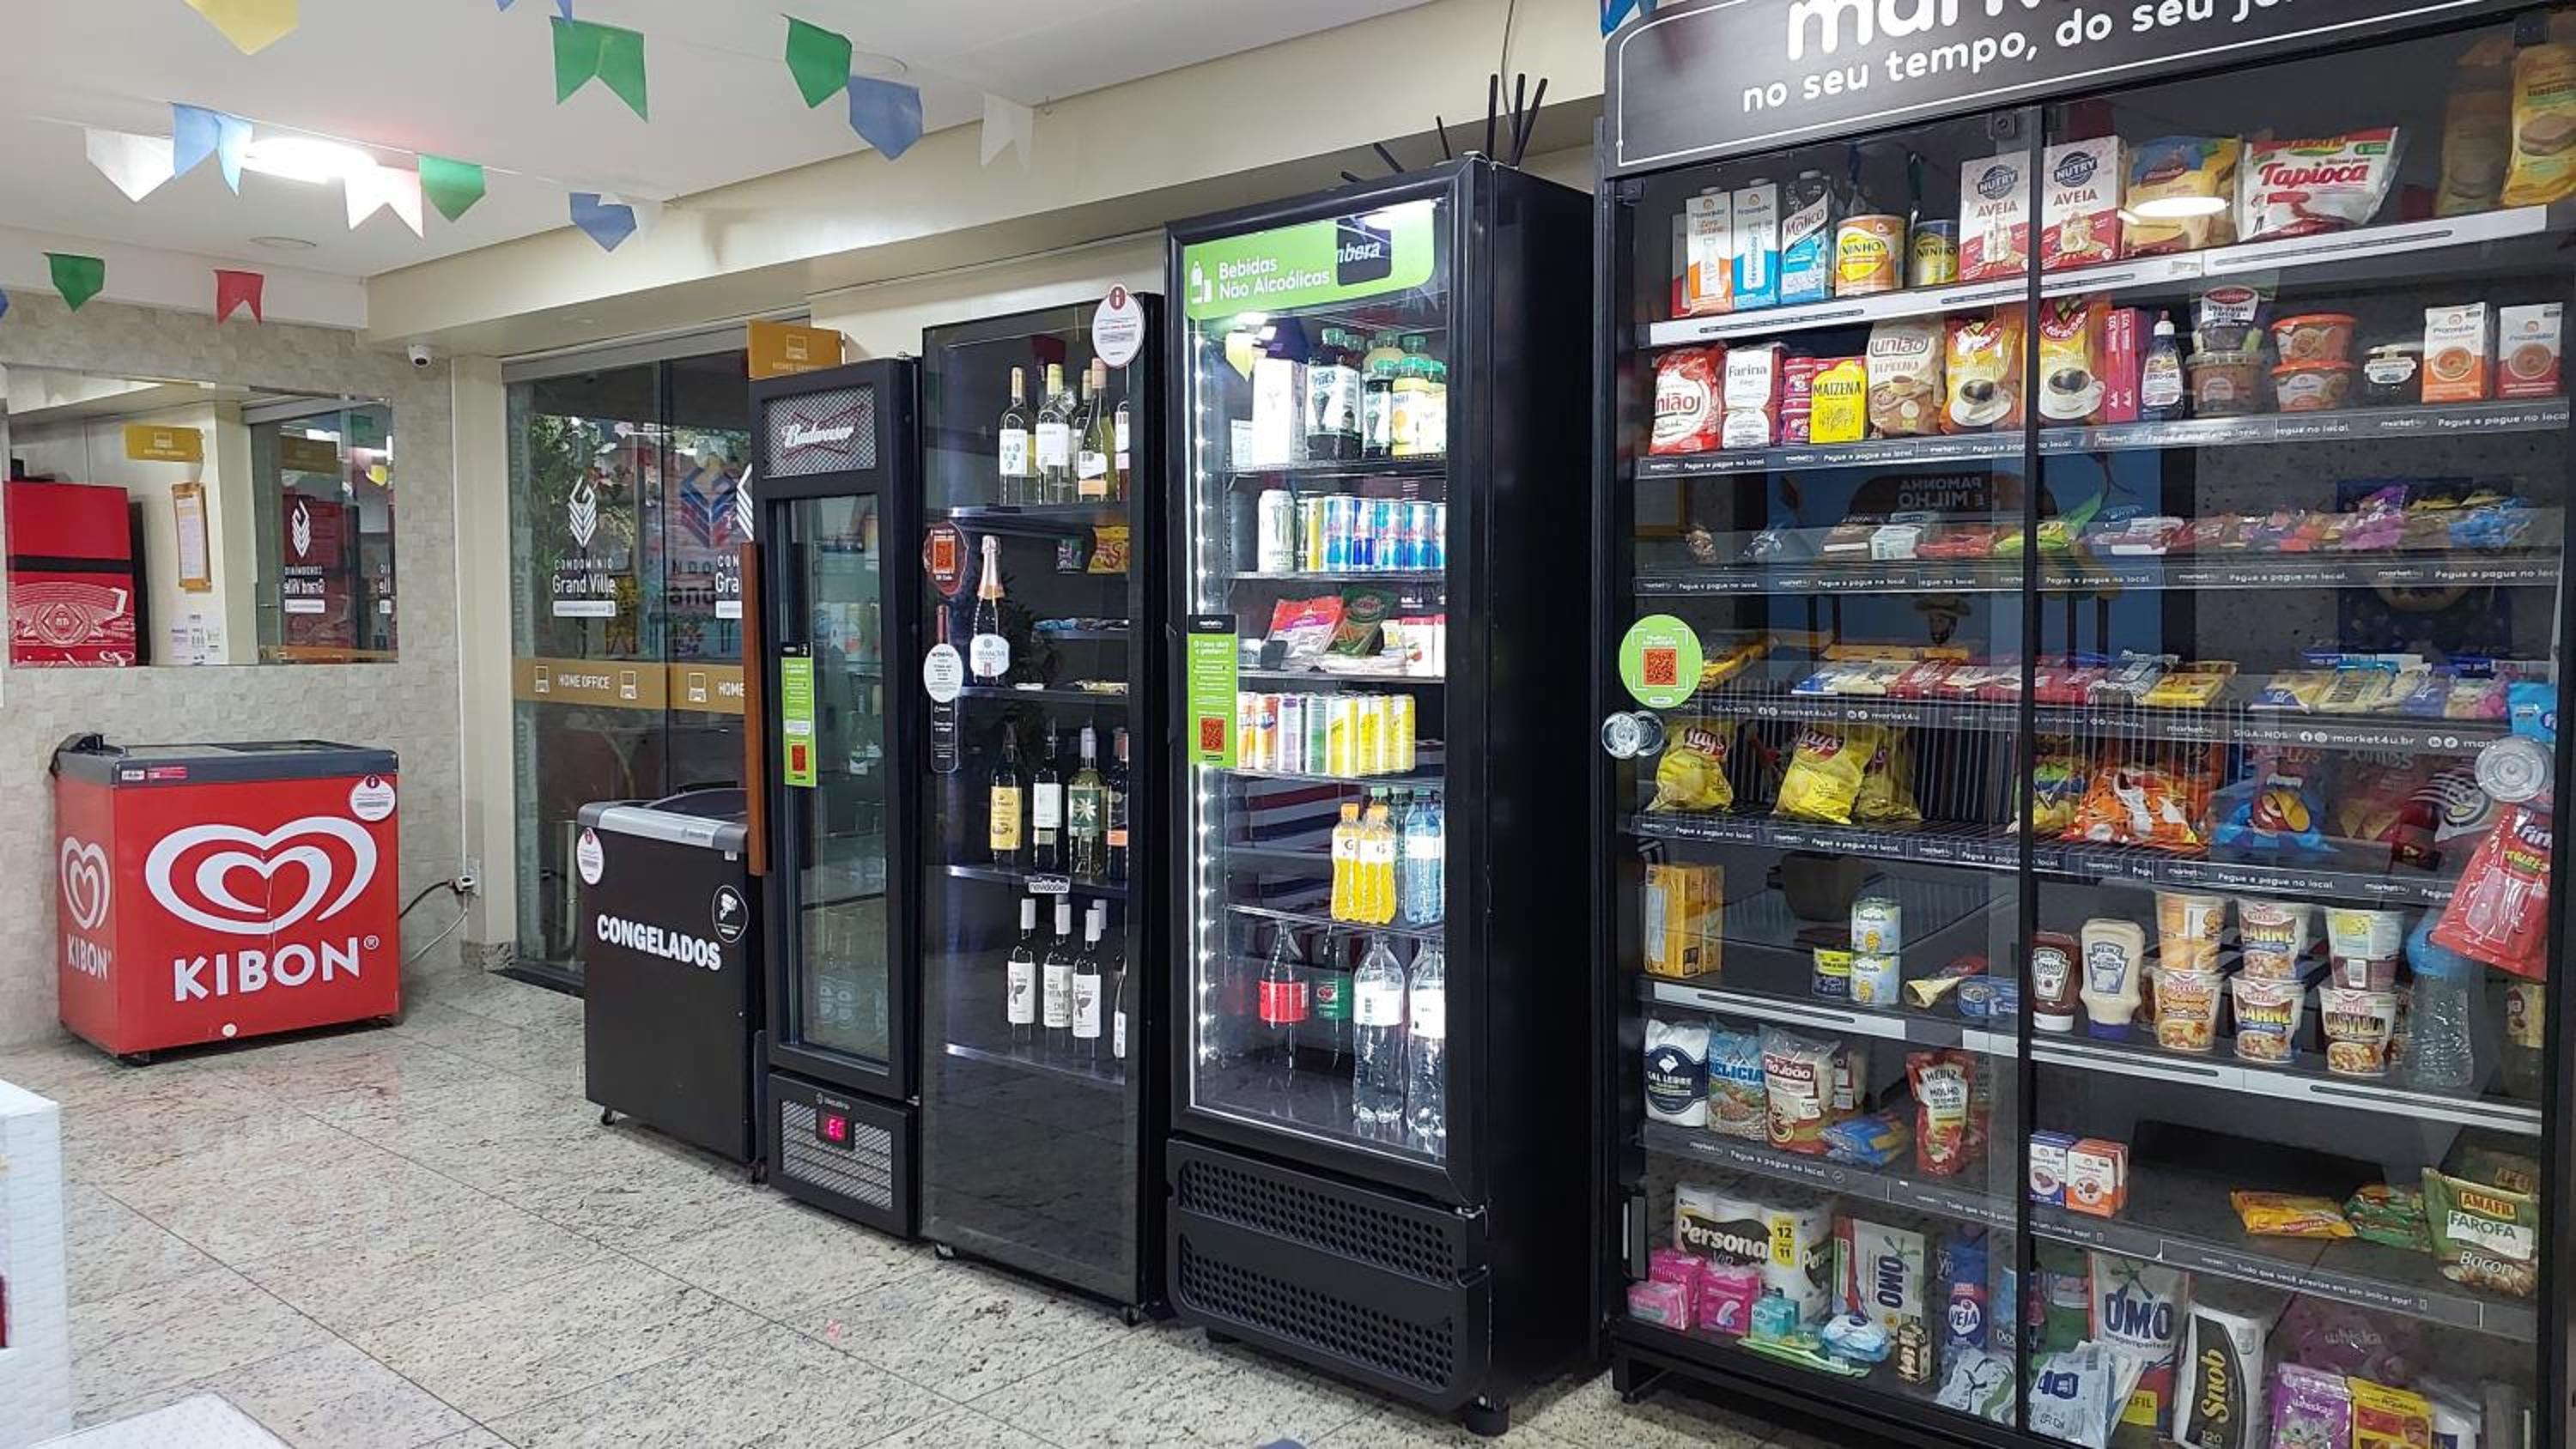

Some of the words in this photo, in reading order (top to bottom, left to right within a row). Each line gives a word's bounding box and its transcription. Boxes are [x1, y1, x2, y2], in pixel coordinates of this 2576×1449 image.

[1743, 82, 1787, 112] no
[1804, 64, 1868, 100] seu
[1886, 32, 2037, 82] tempo,
[2056, 8, 2112, 47] do
[2131, 0, 2213, 32] seu
[2054, 156, 2098, 181] NUTRY
[2258, 162, 2369, 189] Tapioca
[1978, 171, 2018, 193] NUTRY
[1977, 200, 2018, 218] AVEIA
[2053, 188, 2098, 207] AVEIA
[1841, 241, 1880, 256] NINHO
[1917, 246, 1957, 258] NINHO
[1218, 257, 1279, 280] Bebidas
[1218, 281, 1249, 300] Não
[1254, 269, 1330, 296] Alcoólicas
[1814, 380, 1862, 397] MAIZENA
[1656, 391, 1693, 412] nião
[551, 573, 587, 594] Grand
[589, 572, 617, 594] Ville
[715, 571, 740, 594] Gra
[581, 675, 611, 689] OFFICE
[597, 913, 722, 972] CONGELADOS
[68, 933, 109, 981] KIBON
[174, 937, 360, 1003] KIBON
[1779, 1063, 1811, 1080] João
[1926, 1070, 1958, 1082] HEINZ
[1777, 1226, 1793, 1239] 12
[2450, 1210, 2517, 1240] FAROFA
[1678, 1216, 1772, 1260] Personal
[1778, 1247, 1791, 1258] 11
[2460, 1251, 2515, 1276] Bacon
[1878, 1255, 1905, 1310] OMO
[1949, 1310, 1978, 1325] VEJA
[2104, 1291, 2173, 1340] OMO
[2202, 1348, 2230, 1425] Snob
